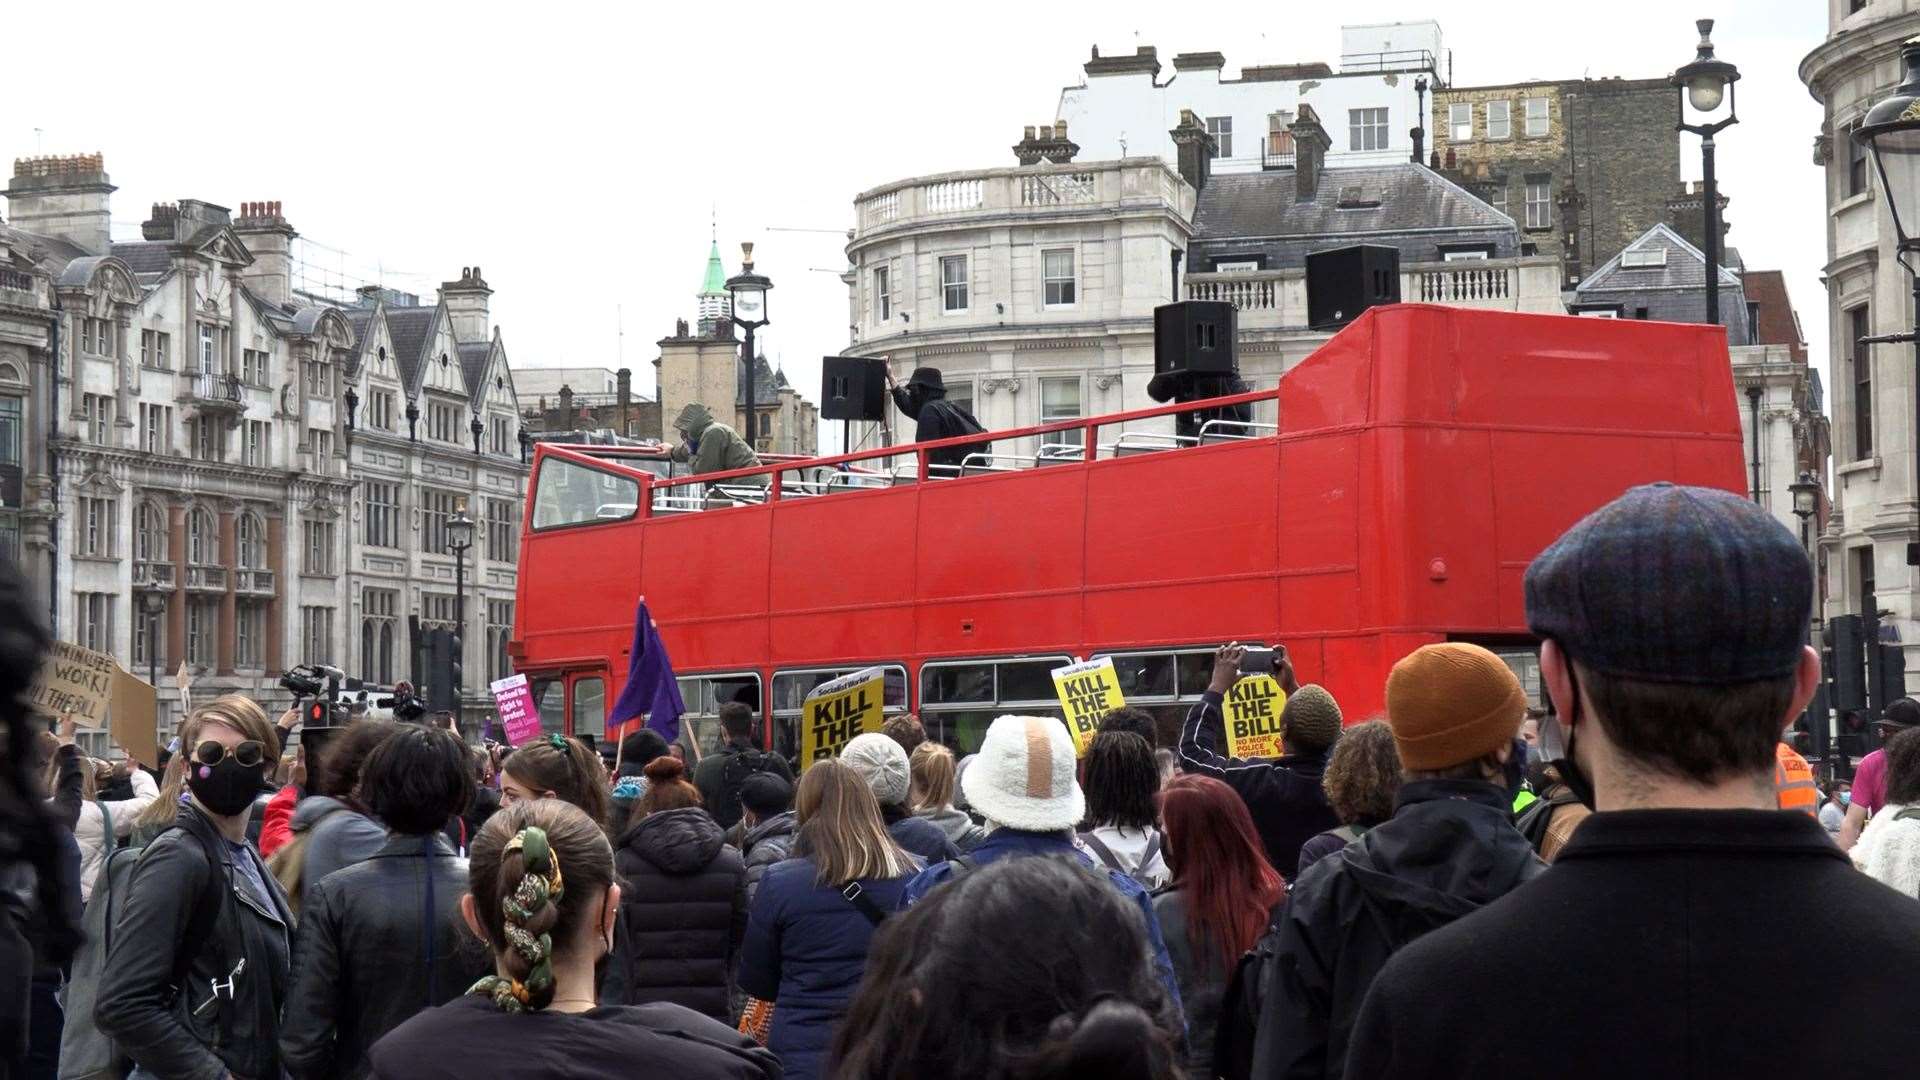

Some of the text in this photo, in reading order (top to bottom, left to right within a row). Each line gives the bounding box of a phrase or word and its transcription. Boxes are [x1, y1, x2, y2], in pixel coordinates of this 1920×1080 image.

[55, 662, 109, 698] WORK!
[1063, 675, 1111, 698] KILL
[496, 687, 527, 702] Defend the
[1229, 681, 1277, 702] KILL
[501, 699, 523, 712] right to
[814, 689, 873, 726] KILL
[1068, 693, 1110, 716] THE
[1230, 699, 1272, 719] THE
[503, 708, 526, 723] protest
[812, 713, 864, 748] THE
[1234, 717, 1280, 738] BILL
[1237, 743, 1264, 752] POLICE
[1249, 735, 1273, 743] MORE
[1237, 749, 1271, 758] POWERS
